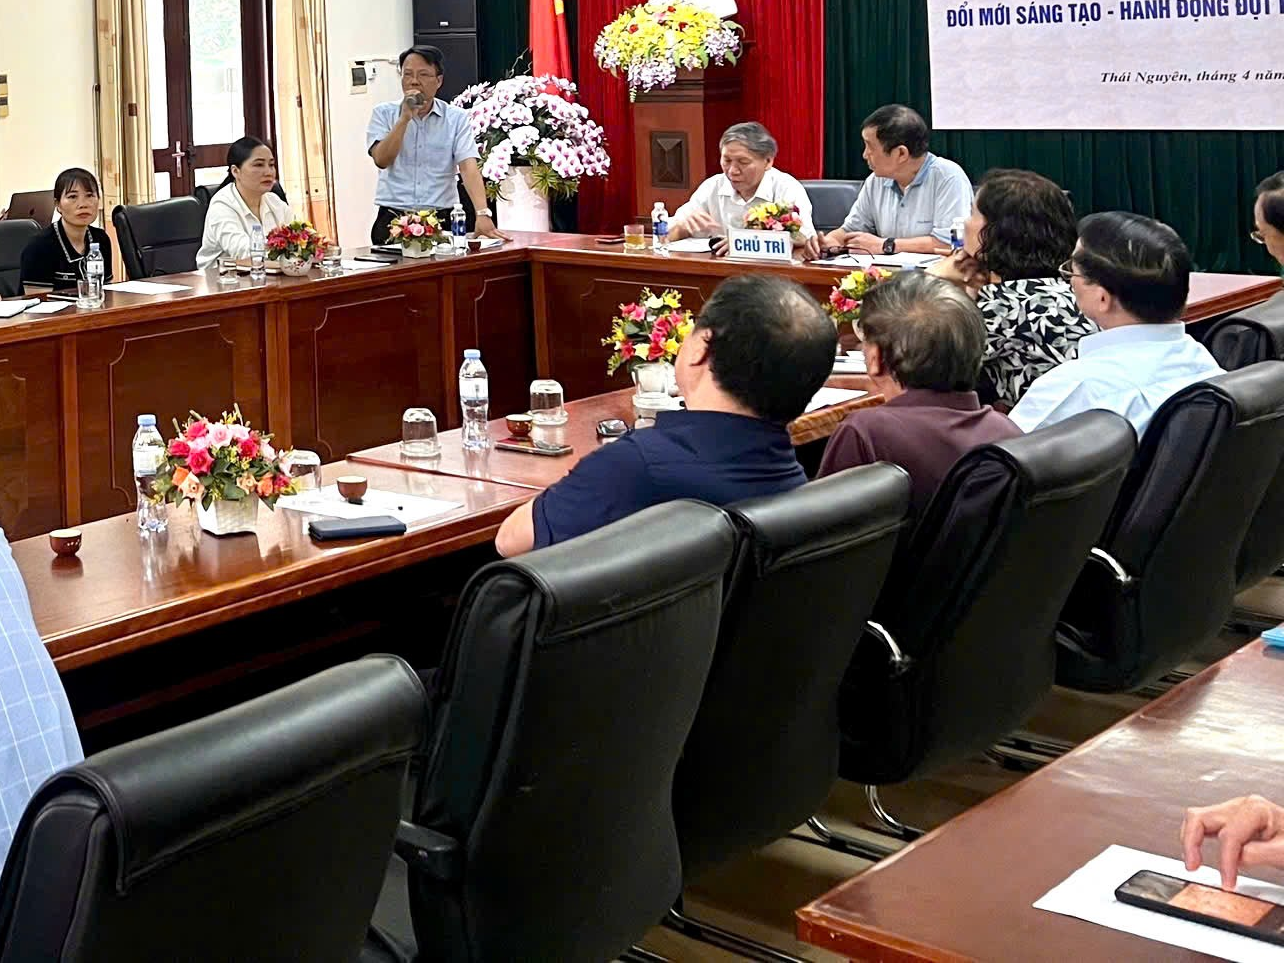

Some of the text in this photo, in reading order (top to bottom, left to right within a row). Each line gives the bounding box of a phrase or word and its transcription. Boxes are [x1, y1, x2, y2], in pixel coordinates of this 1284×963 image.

[946, 0, 973, 27] ĐỔI
[979, 2, 1010, 26] MỚI
[1016, 1, 1063, 25] SÁNG
[1068, 2, 1101, 27] TẠO
[1100, 71, 1131, 82] Thái
[1135, 71, 1192, 84] Nguyên,
[1196, 70, 1237, 83] tháng
[1242, 70, 1251, 80] 4
[734, 235, 785, 254] CHỦ TRÌ
